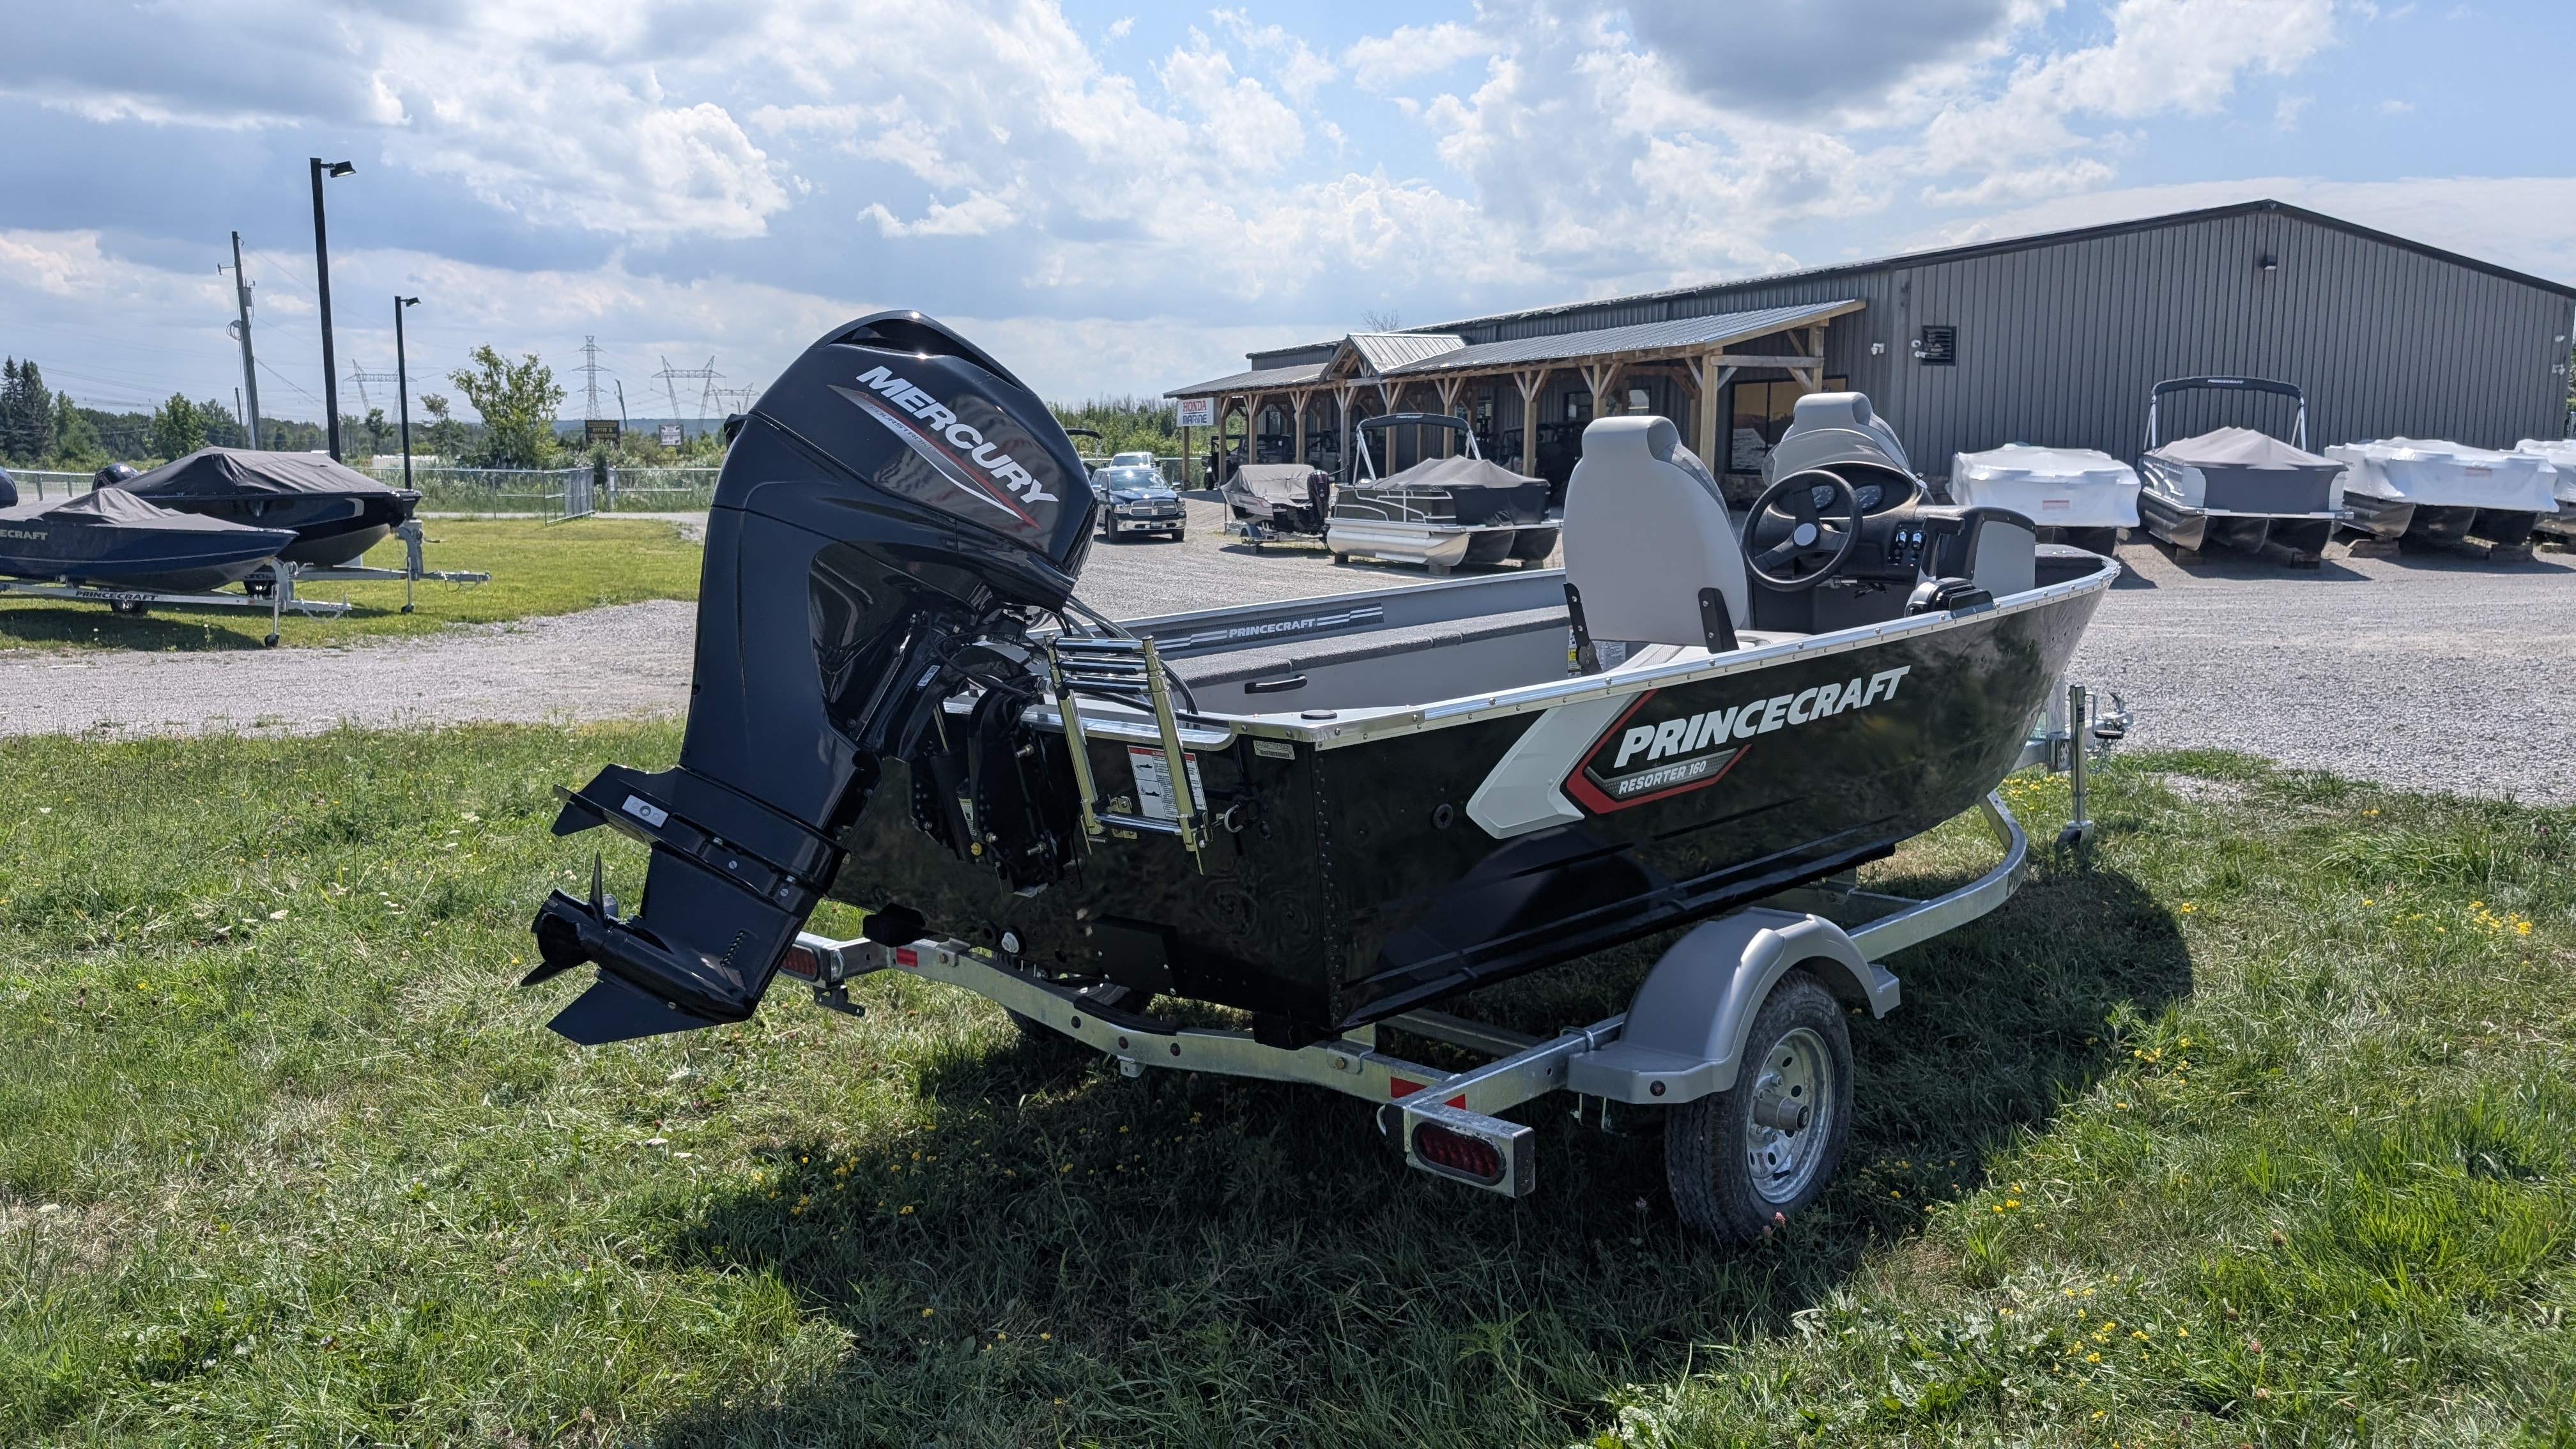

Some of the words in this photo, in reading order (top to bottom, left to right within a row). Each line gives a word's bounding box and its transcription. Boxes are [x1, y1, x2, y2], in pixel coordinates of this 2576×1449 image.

[1183, 400, 1207, 412] HONDA
[856, 365, 1059, 503] MERCURY
[869, 406, 937, 452] FOURSTROKE
[75, 590, 158, 601] PRINCECRAFT
[1229, 618, 1315, 638] PRINCECRAFT
[1614, 665, 1911, 768] PRINCECRAFT
[1618, 766, 1687, 795] RESORTER
[1689, 760, 1706, 776] 160
